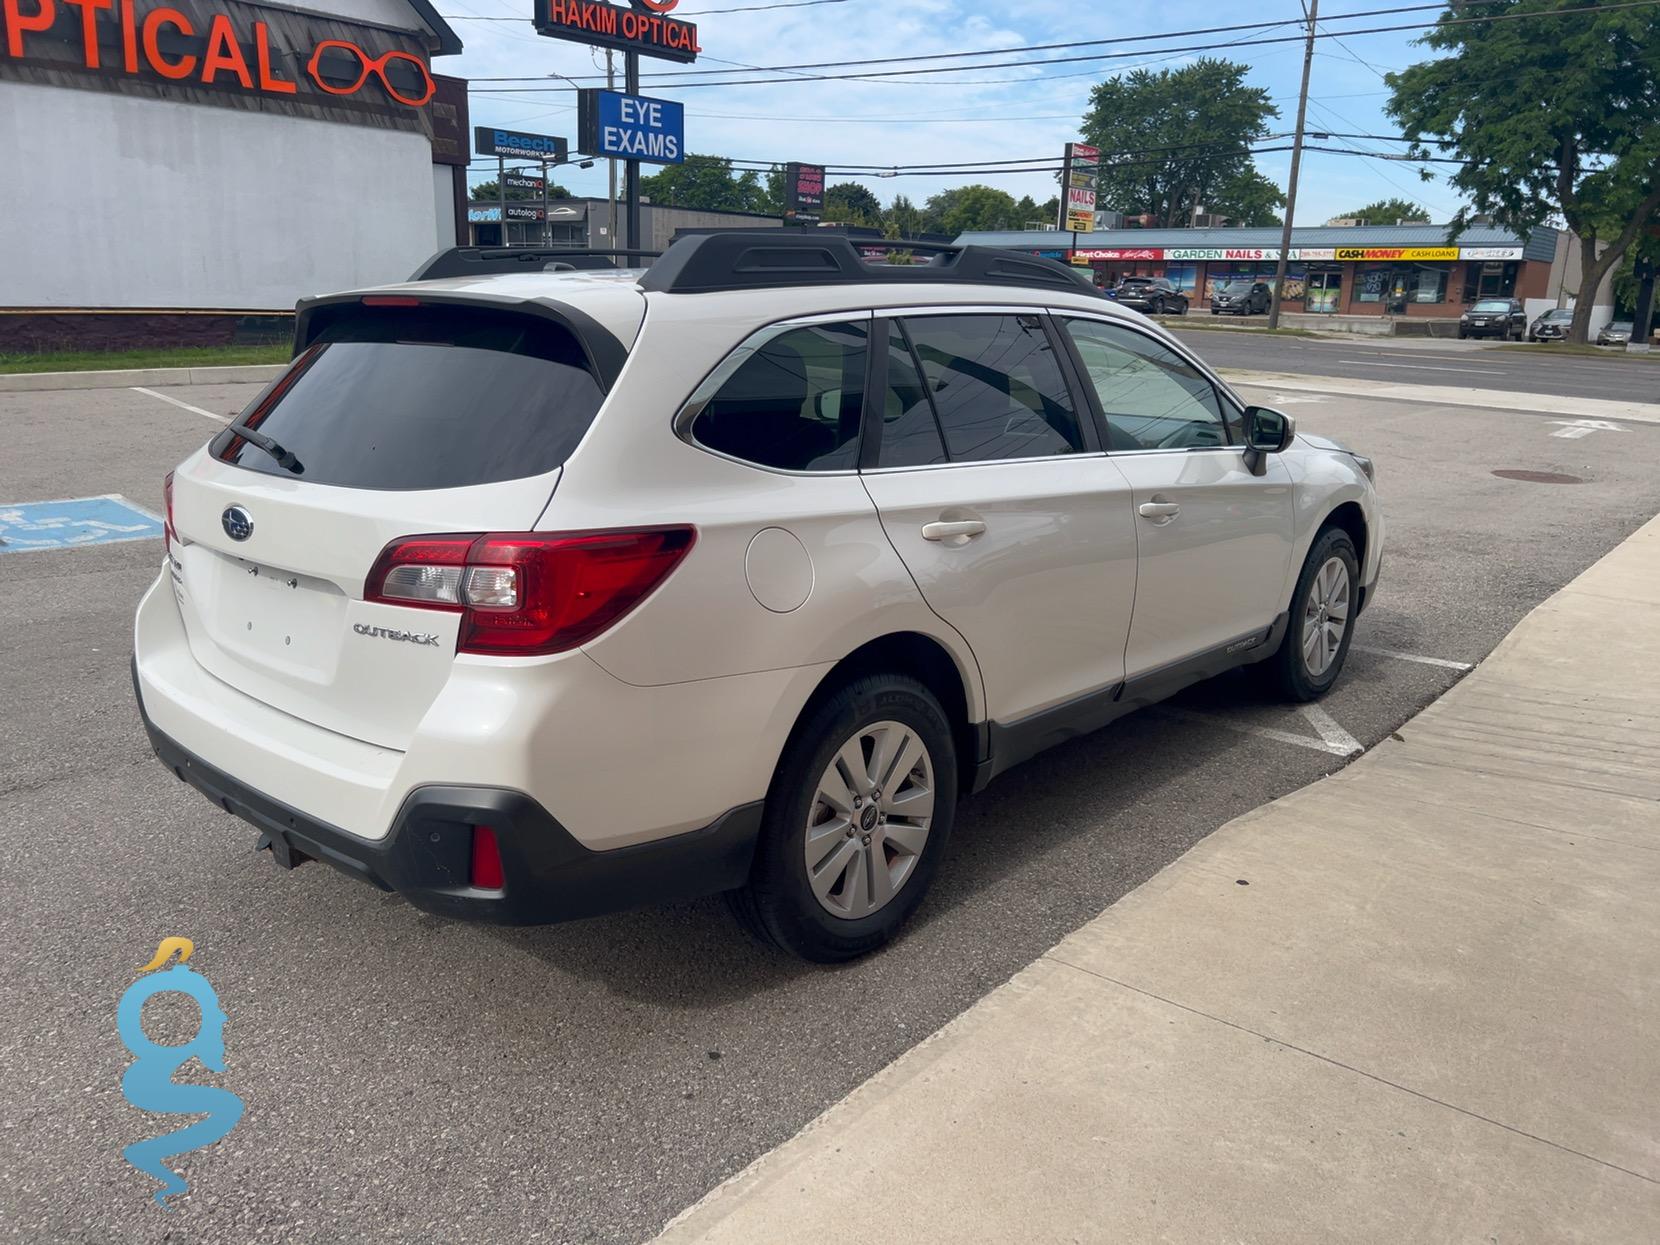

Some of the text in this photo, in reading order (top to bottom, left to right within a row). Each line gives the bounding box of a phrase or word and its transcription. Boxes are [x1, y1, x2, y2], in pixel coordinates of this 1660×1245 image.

[551, 0, 702, 52] HAKIM OPTICAL
[3, 0, 297, 94] PTICAL
[620, 97, 663, 128] EYE
[494, 130, 556, 152] Beech
[603, 126, 678, 160] EXAMS
[1069, 190, 1095, 205] NAILS
[1094, 250, 1120, 258] Choice
[1172, 250, 1223, 259] GARDEN
[1225, 250, 1263, 259] NAILS
[1275, 250, 1297, 259] SA
[353, 623, 439, 647] OUTBACK
